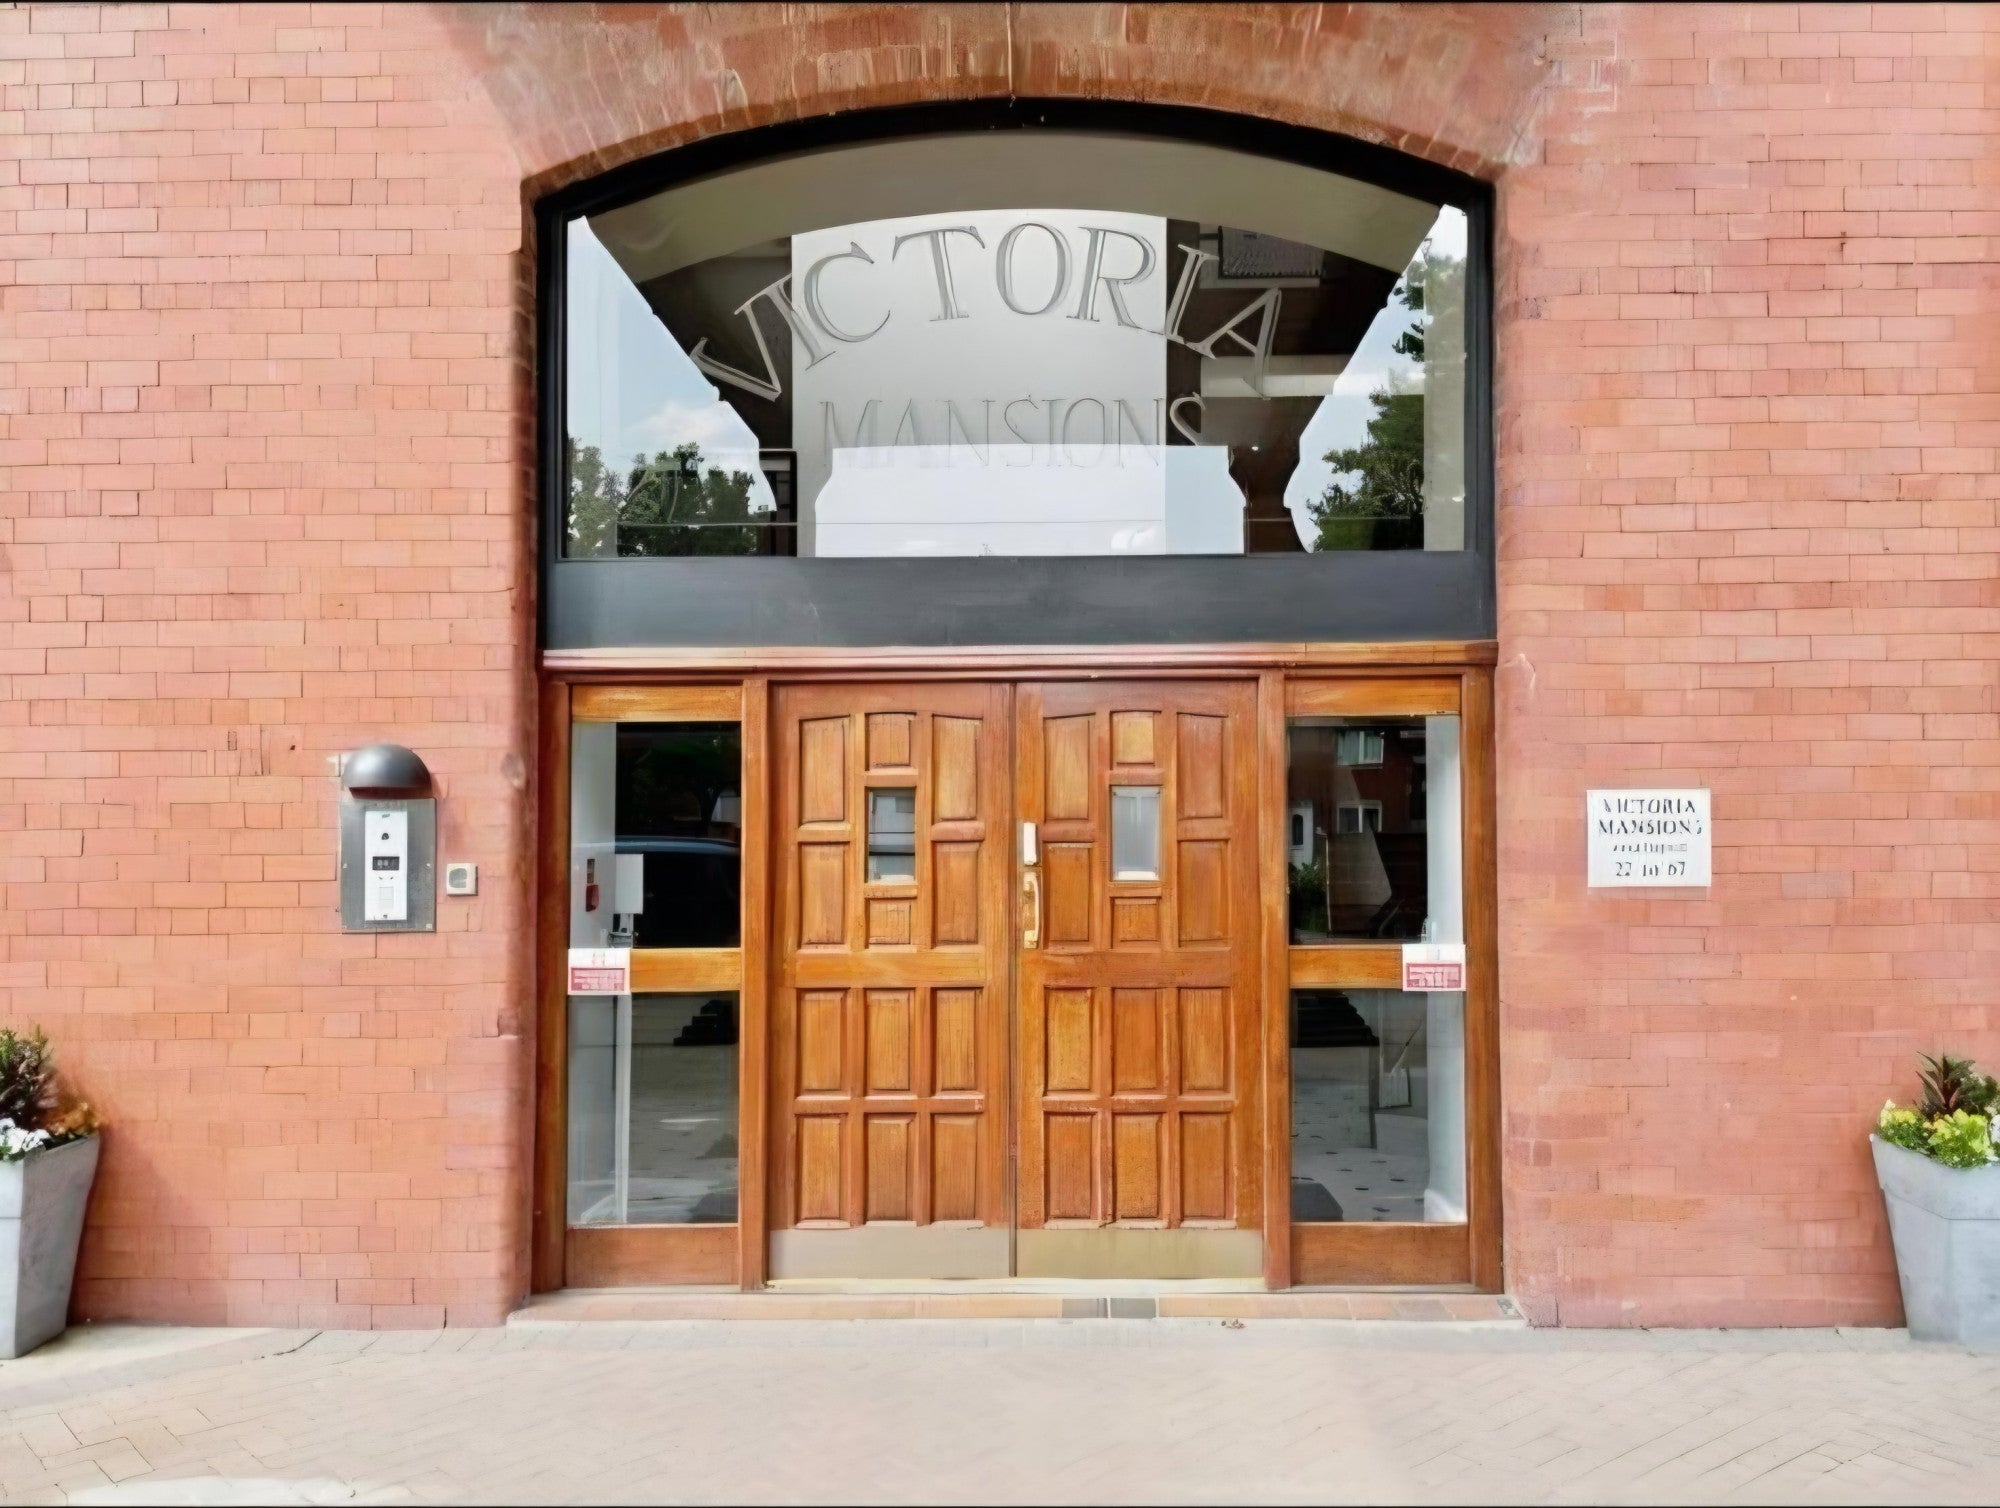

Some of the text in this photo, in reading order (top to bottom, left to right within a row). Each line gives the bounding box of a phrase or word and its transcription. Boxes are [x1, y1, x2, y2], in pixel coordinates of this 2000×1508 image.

[688, 223, 1282, 401] VICTORIA
[820, 393, 1206, 467] MANSIONS
[1599, 819, 1702, 834] MANSIONS
[1603, 798, 1695, 814] VICTORIA
